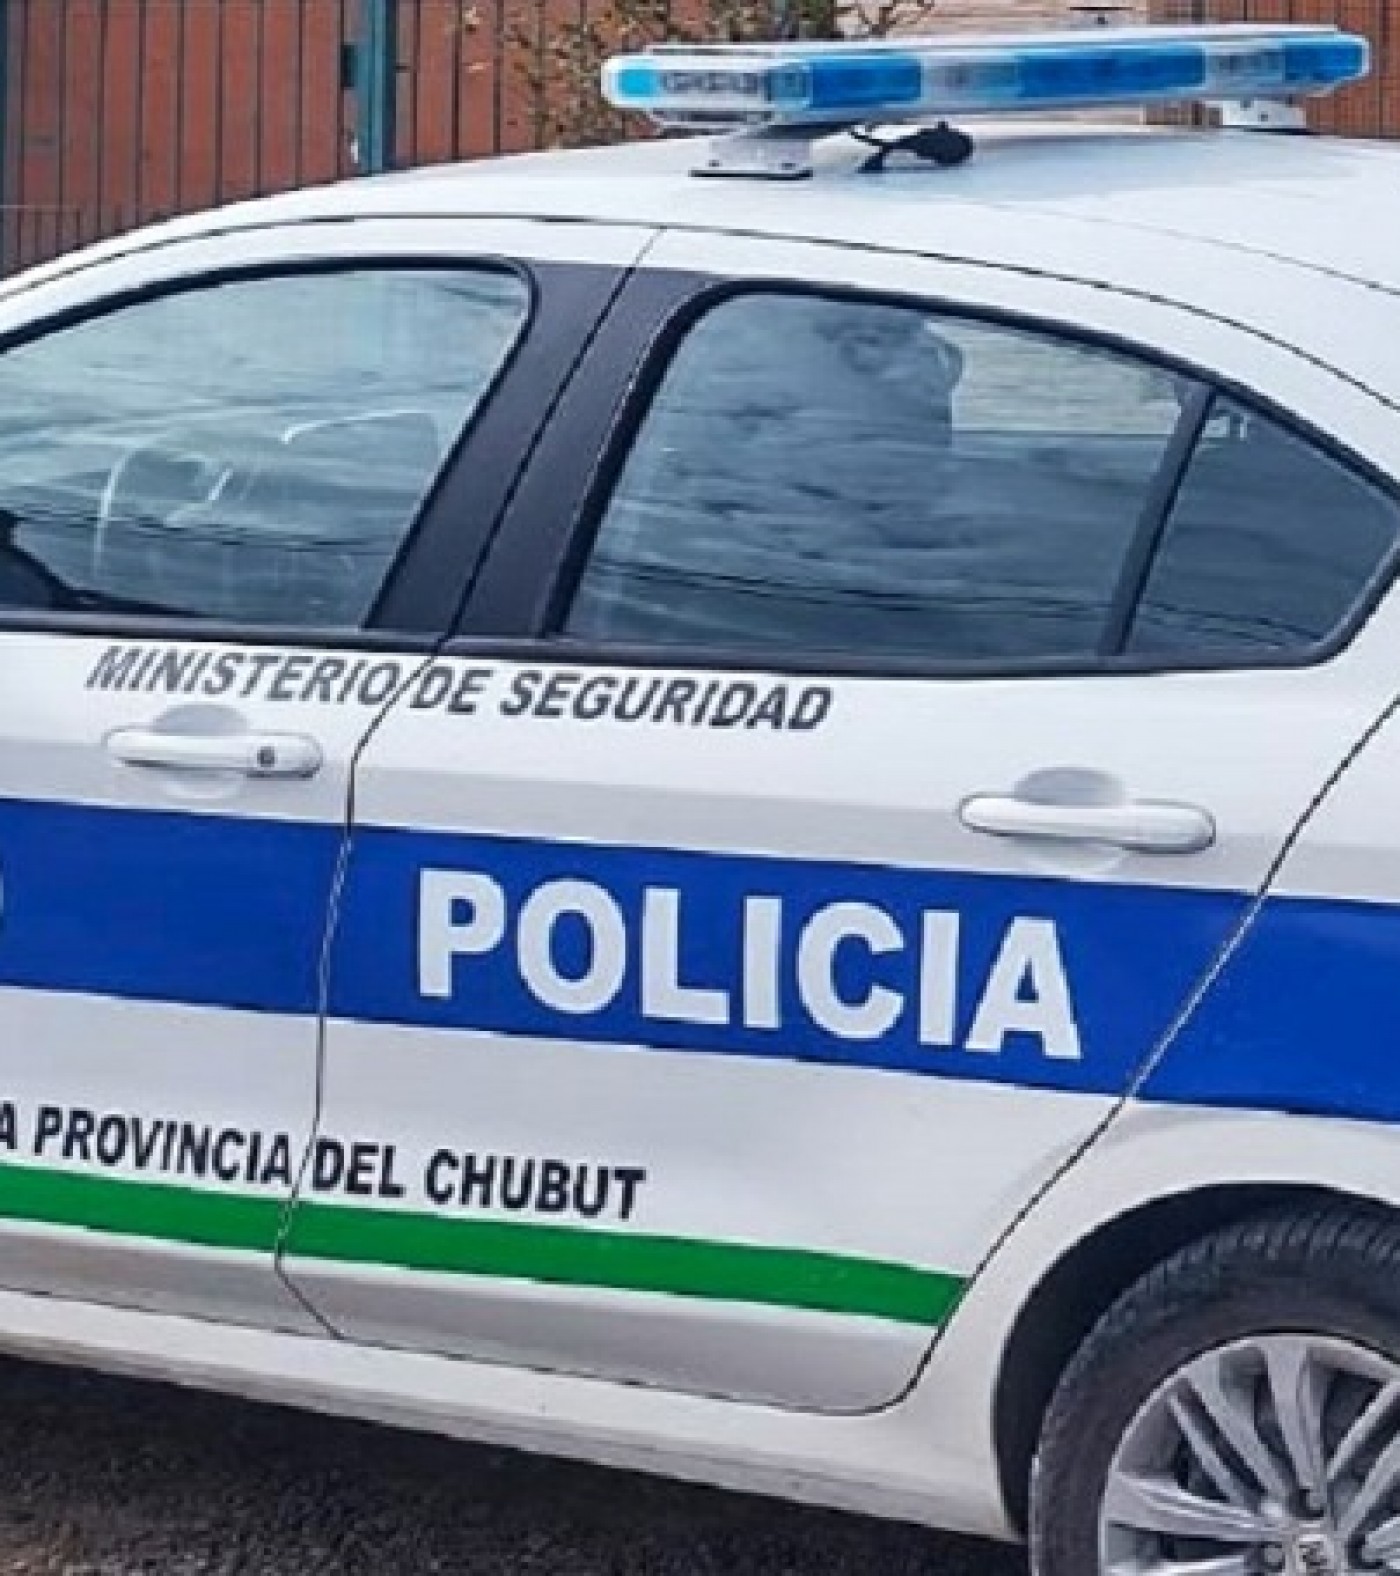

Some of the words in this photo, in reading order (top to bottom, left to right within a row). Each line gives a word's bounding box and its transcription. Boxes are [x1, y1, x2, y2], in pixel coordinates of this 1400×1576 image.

[85, 644, 400, 708] MINISTERIO
[409, 663, 491, 716] DE
[499, 670, 834, 731] SEGURIDAD
[418, 867, 1082, 1061] POLICIA
[34, 1104, 293, 1187] PROVINCIA
[312, 1137, 405, 1198] DEL
[424, 1147, 647, 1221] CHUBUT
